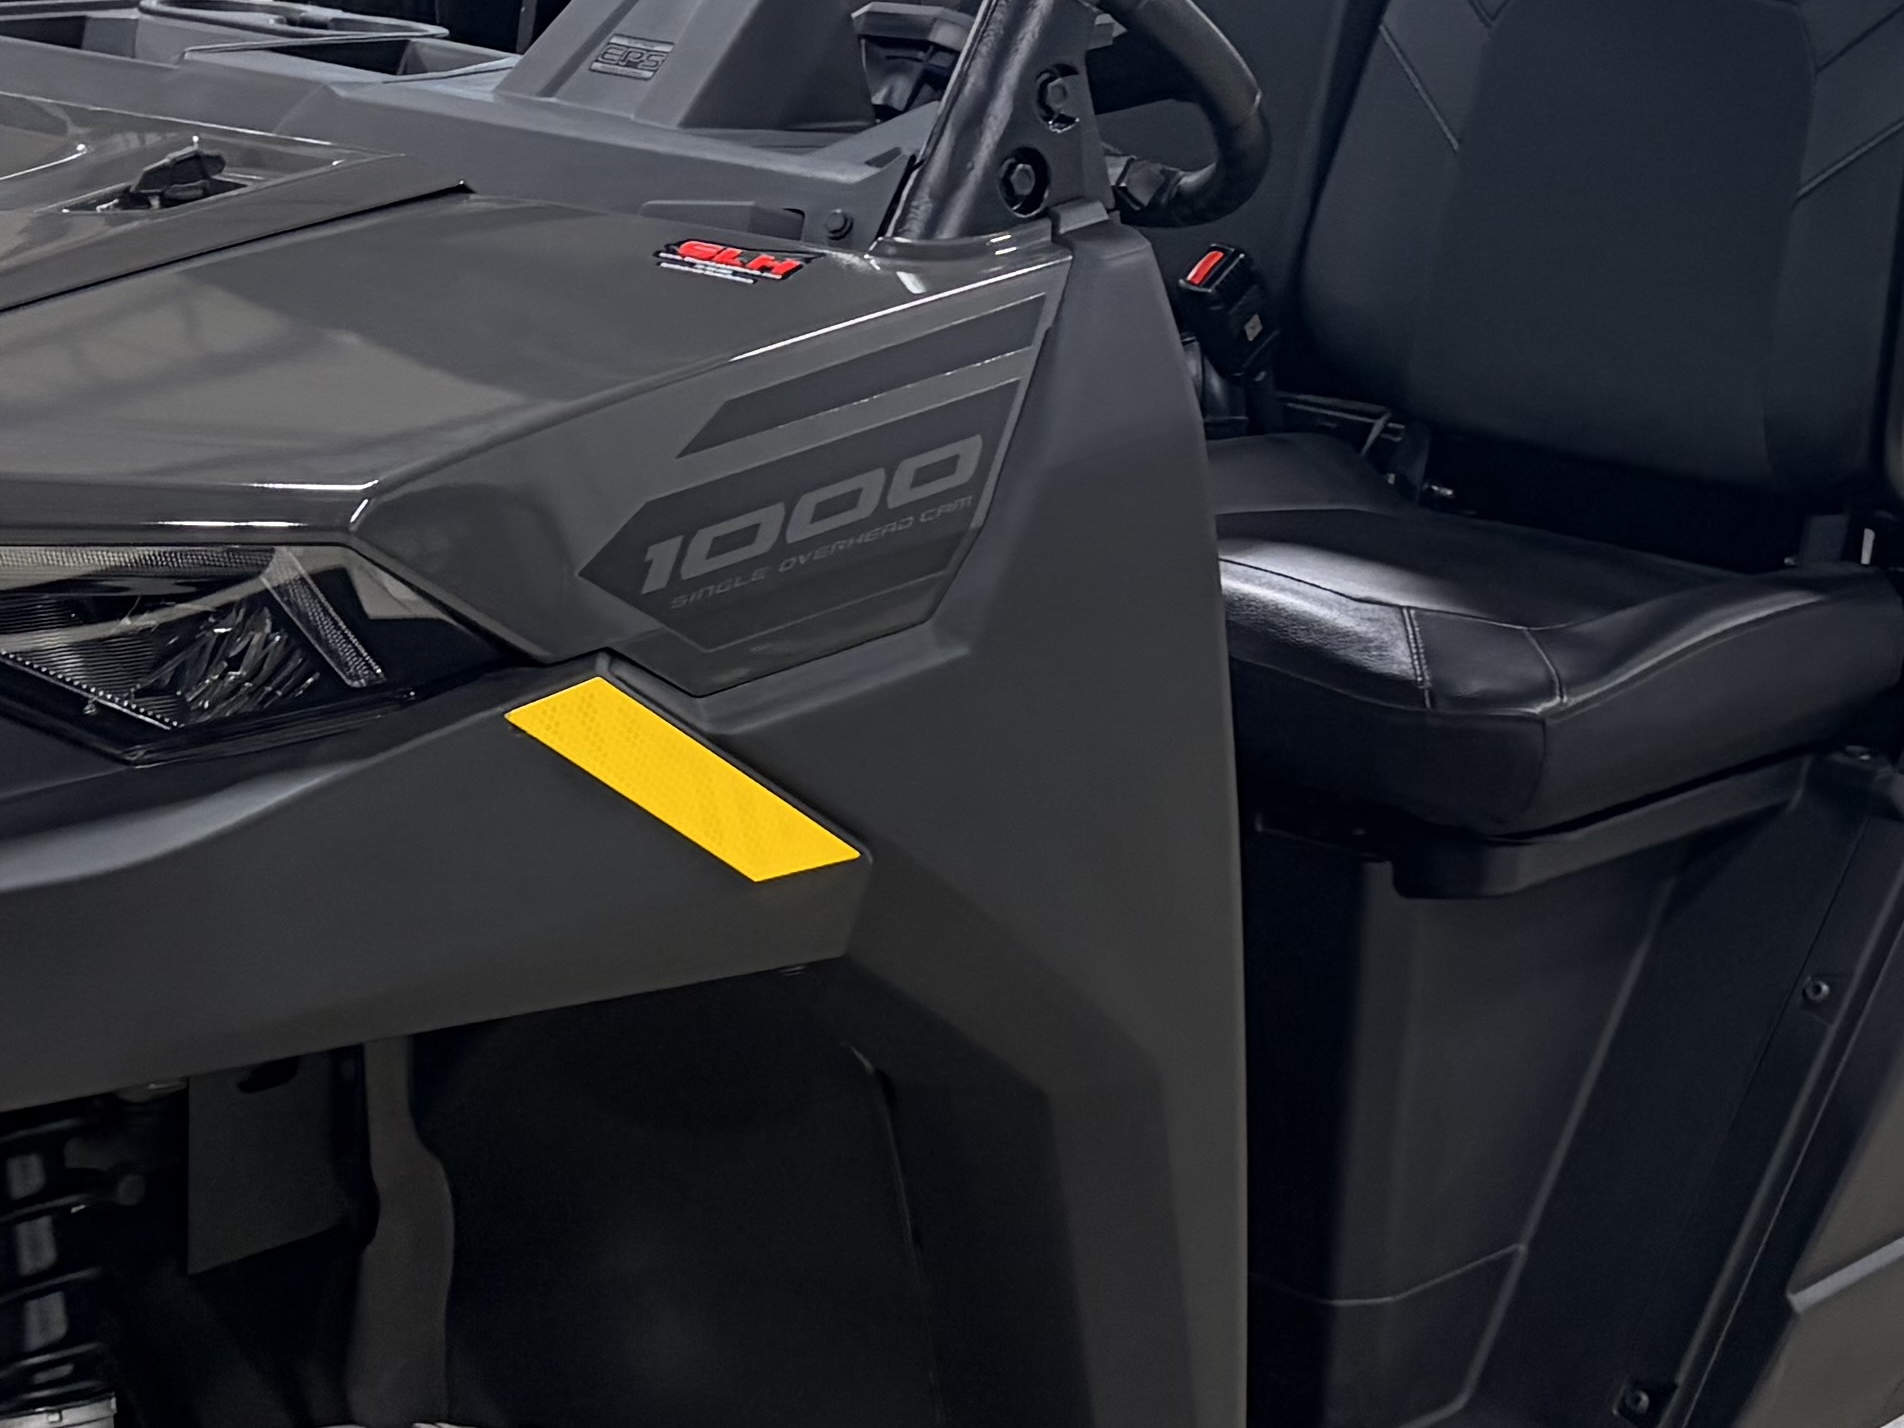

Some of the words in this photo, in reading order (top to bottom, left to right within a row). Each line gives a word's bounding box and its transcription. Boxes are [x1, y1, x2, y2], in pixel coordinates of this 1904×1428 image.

[597, 43, 669, 71] EPS
[640, 433, 983, 595] 1000
[671, 566, 770, 610] SINGLE
[778, 516, 914, 573] OVERHEAD
[919, 495, 973, 525] CAM
